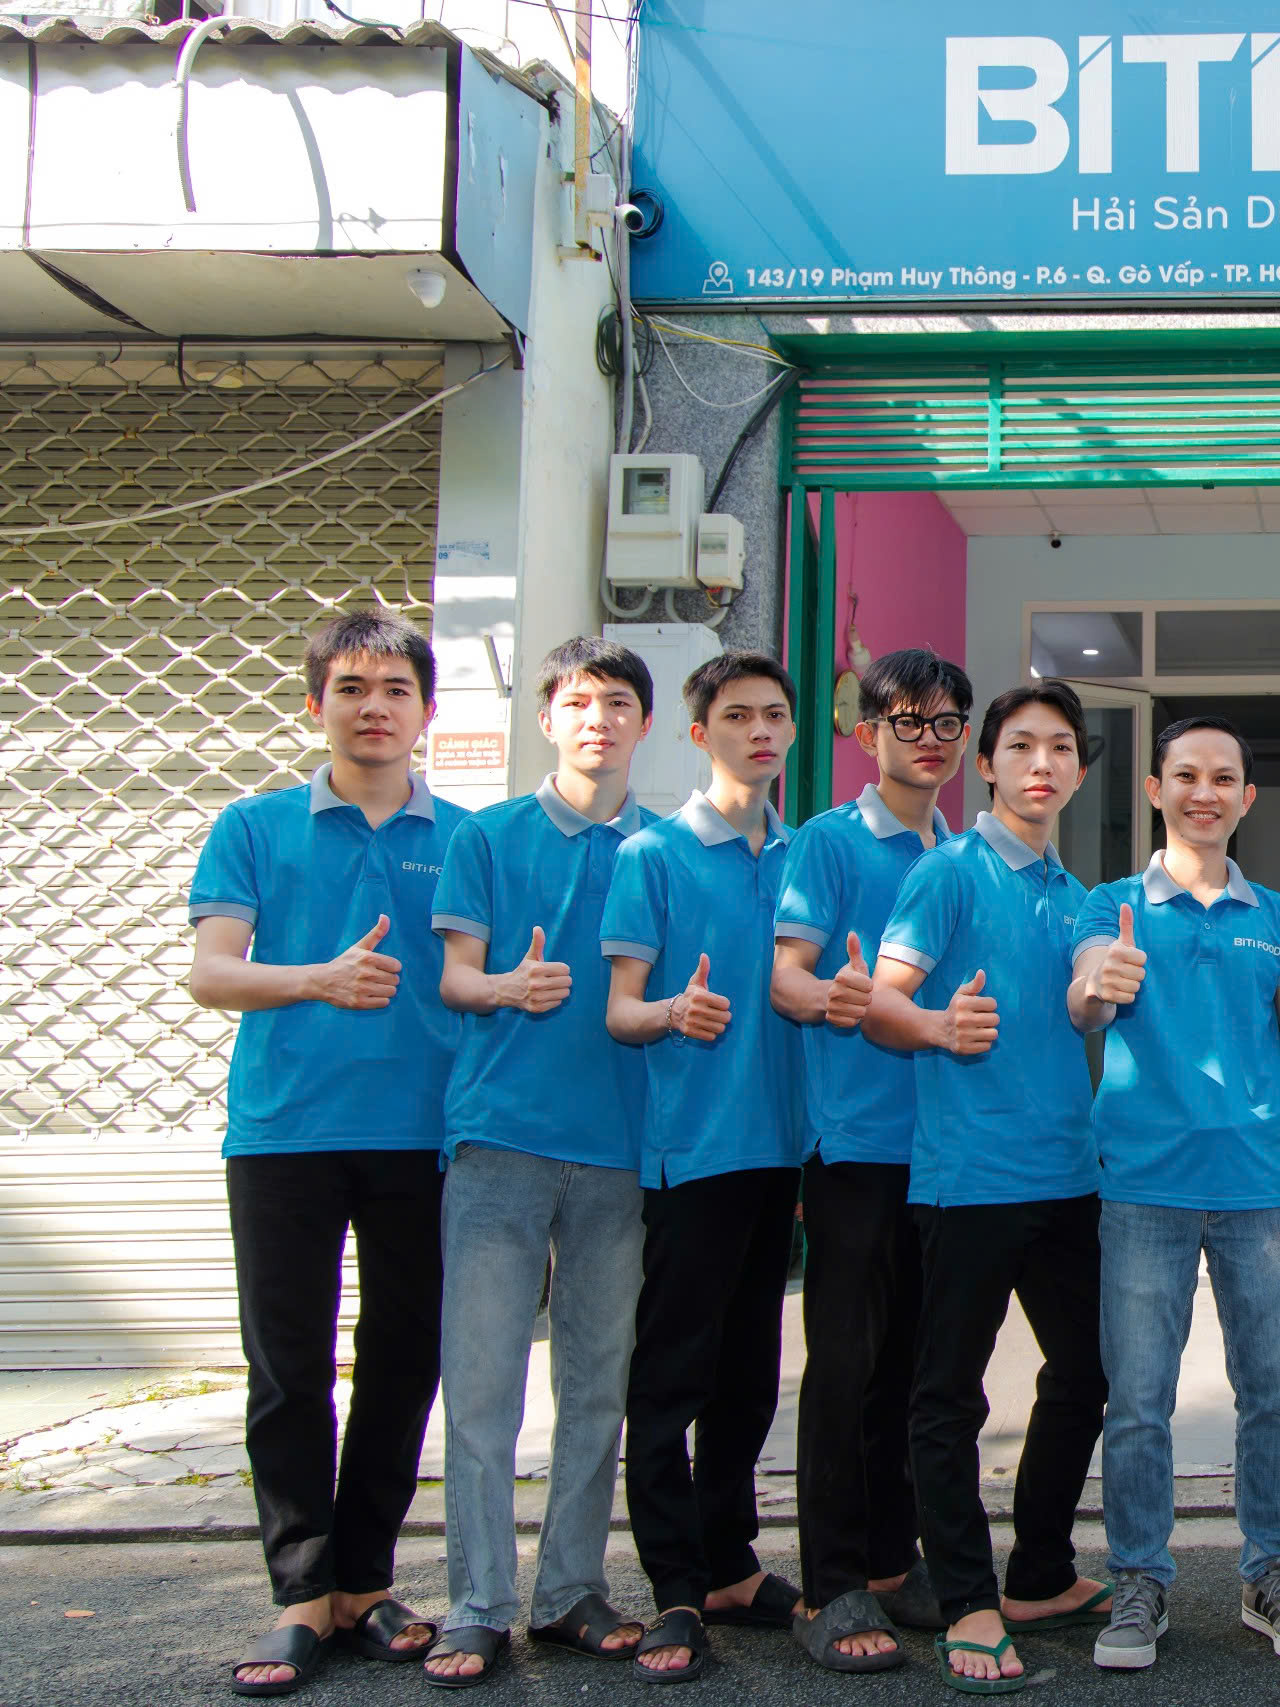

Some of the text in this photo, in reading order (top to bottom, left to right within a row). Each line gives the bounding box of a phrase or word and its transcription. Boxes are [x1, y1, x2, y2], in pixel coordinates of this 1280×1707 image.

[1072, 195, 1136, 231] Hải
[1153, 195, 1228, 230] Sản
[747, 268, 825, 289] 143/19
[831, 267, 893, 291] Phạm
[901, 267, 943, 289] Huy
[949, 265, 1017, 290] Thông
[1036, 266, 1067, 285] P.6
[1119, 263, 1151, 283] Gò
[1158, 260, 1205, 287] Vấp
[1223, 264, 1252, 283] TP.
[402, 861, 427, 873] BITI
[1233, 937, 1256, 948] BITI
